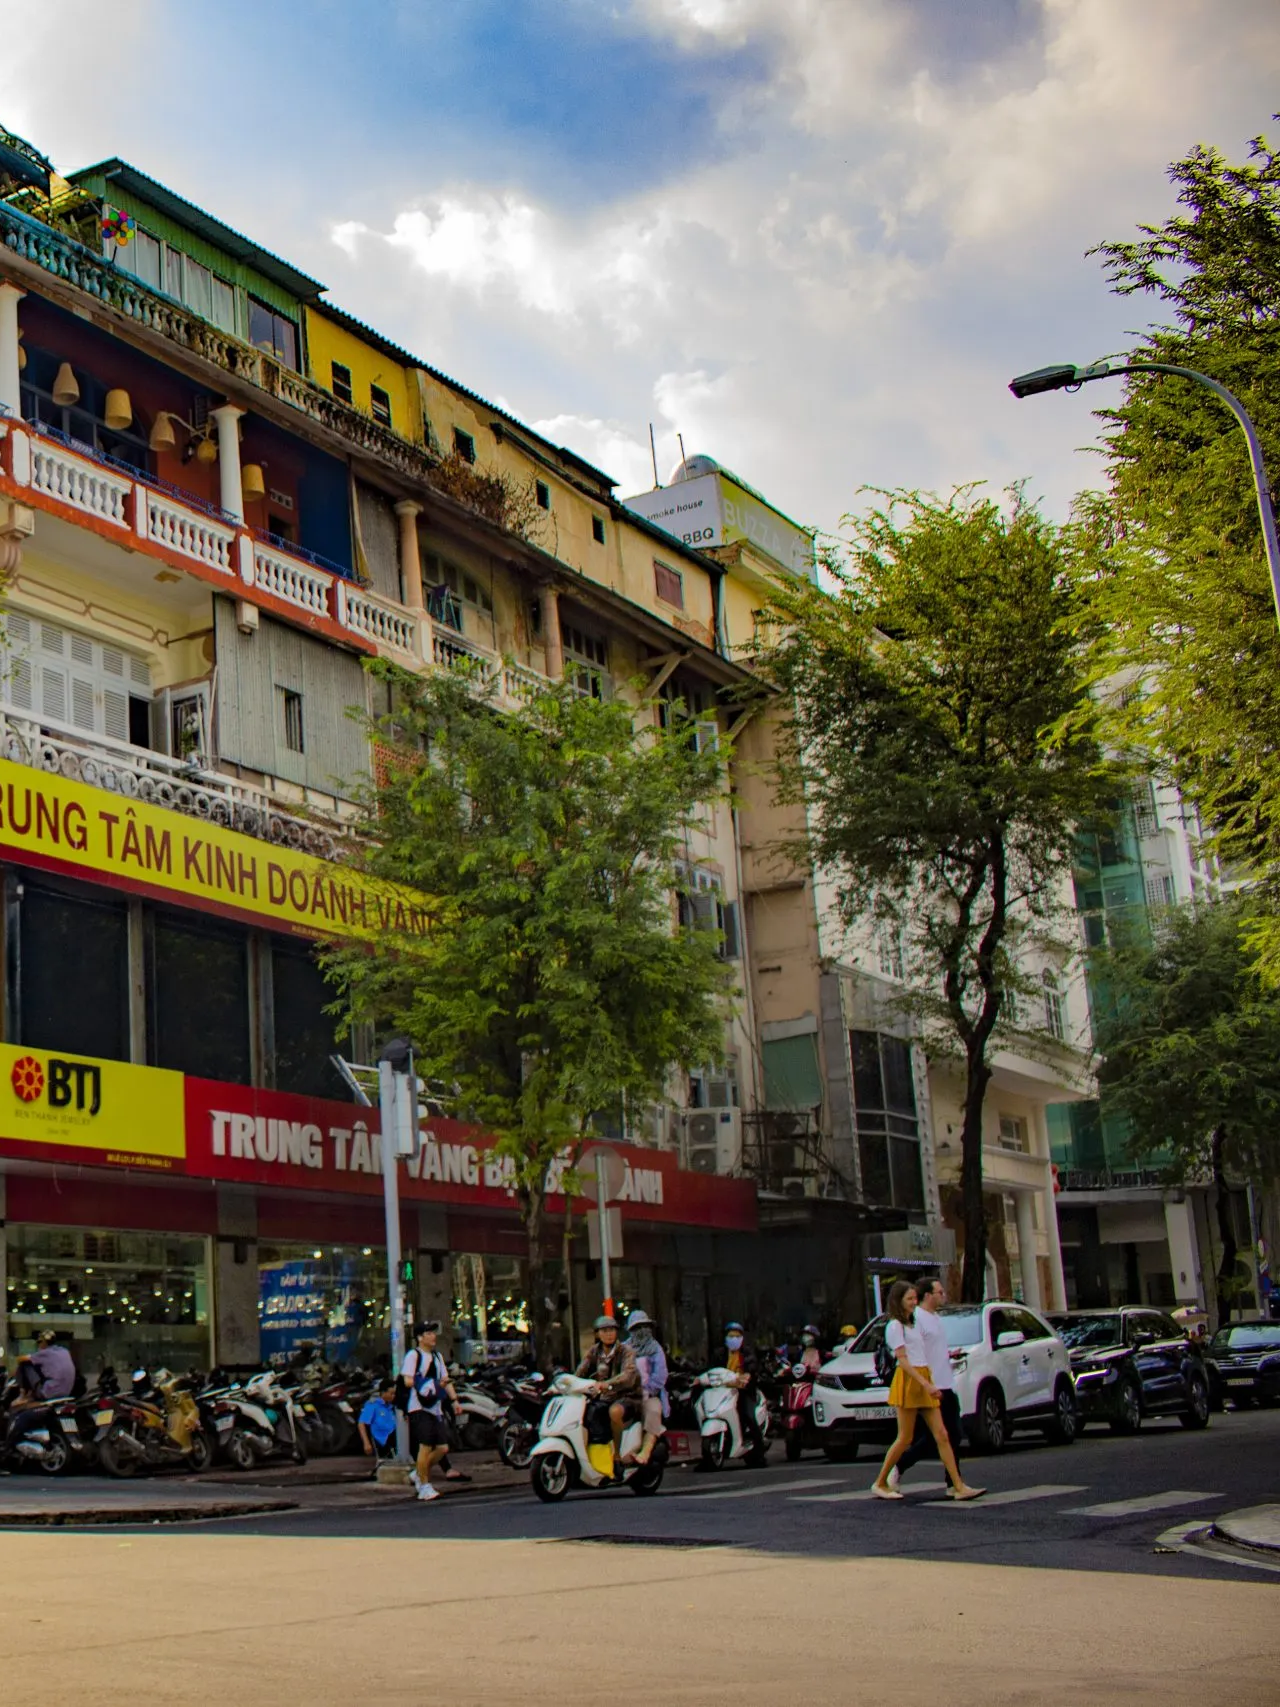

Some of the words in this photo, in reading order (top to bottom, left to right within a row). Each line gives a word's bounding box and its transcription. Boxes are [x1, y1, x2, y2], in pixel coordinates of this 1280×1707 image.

[676, 499, 703, 513] house
[682, 527, 714, 545] BBQ
[98, 806, 173, 876] TÂM
[182, 833, 258, 901] KINH
[267, 861, 369, 930] DOANH
[47, 1058, 101, 1117] BTJ
[209, 1110, 323, 1169] TRUNG
[484, 1148, 530, 1197] BẠ
